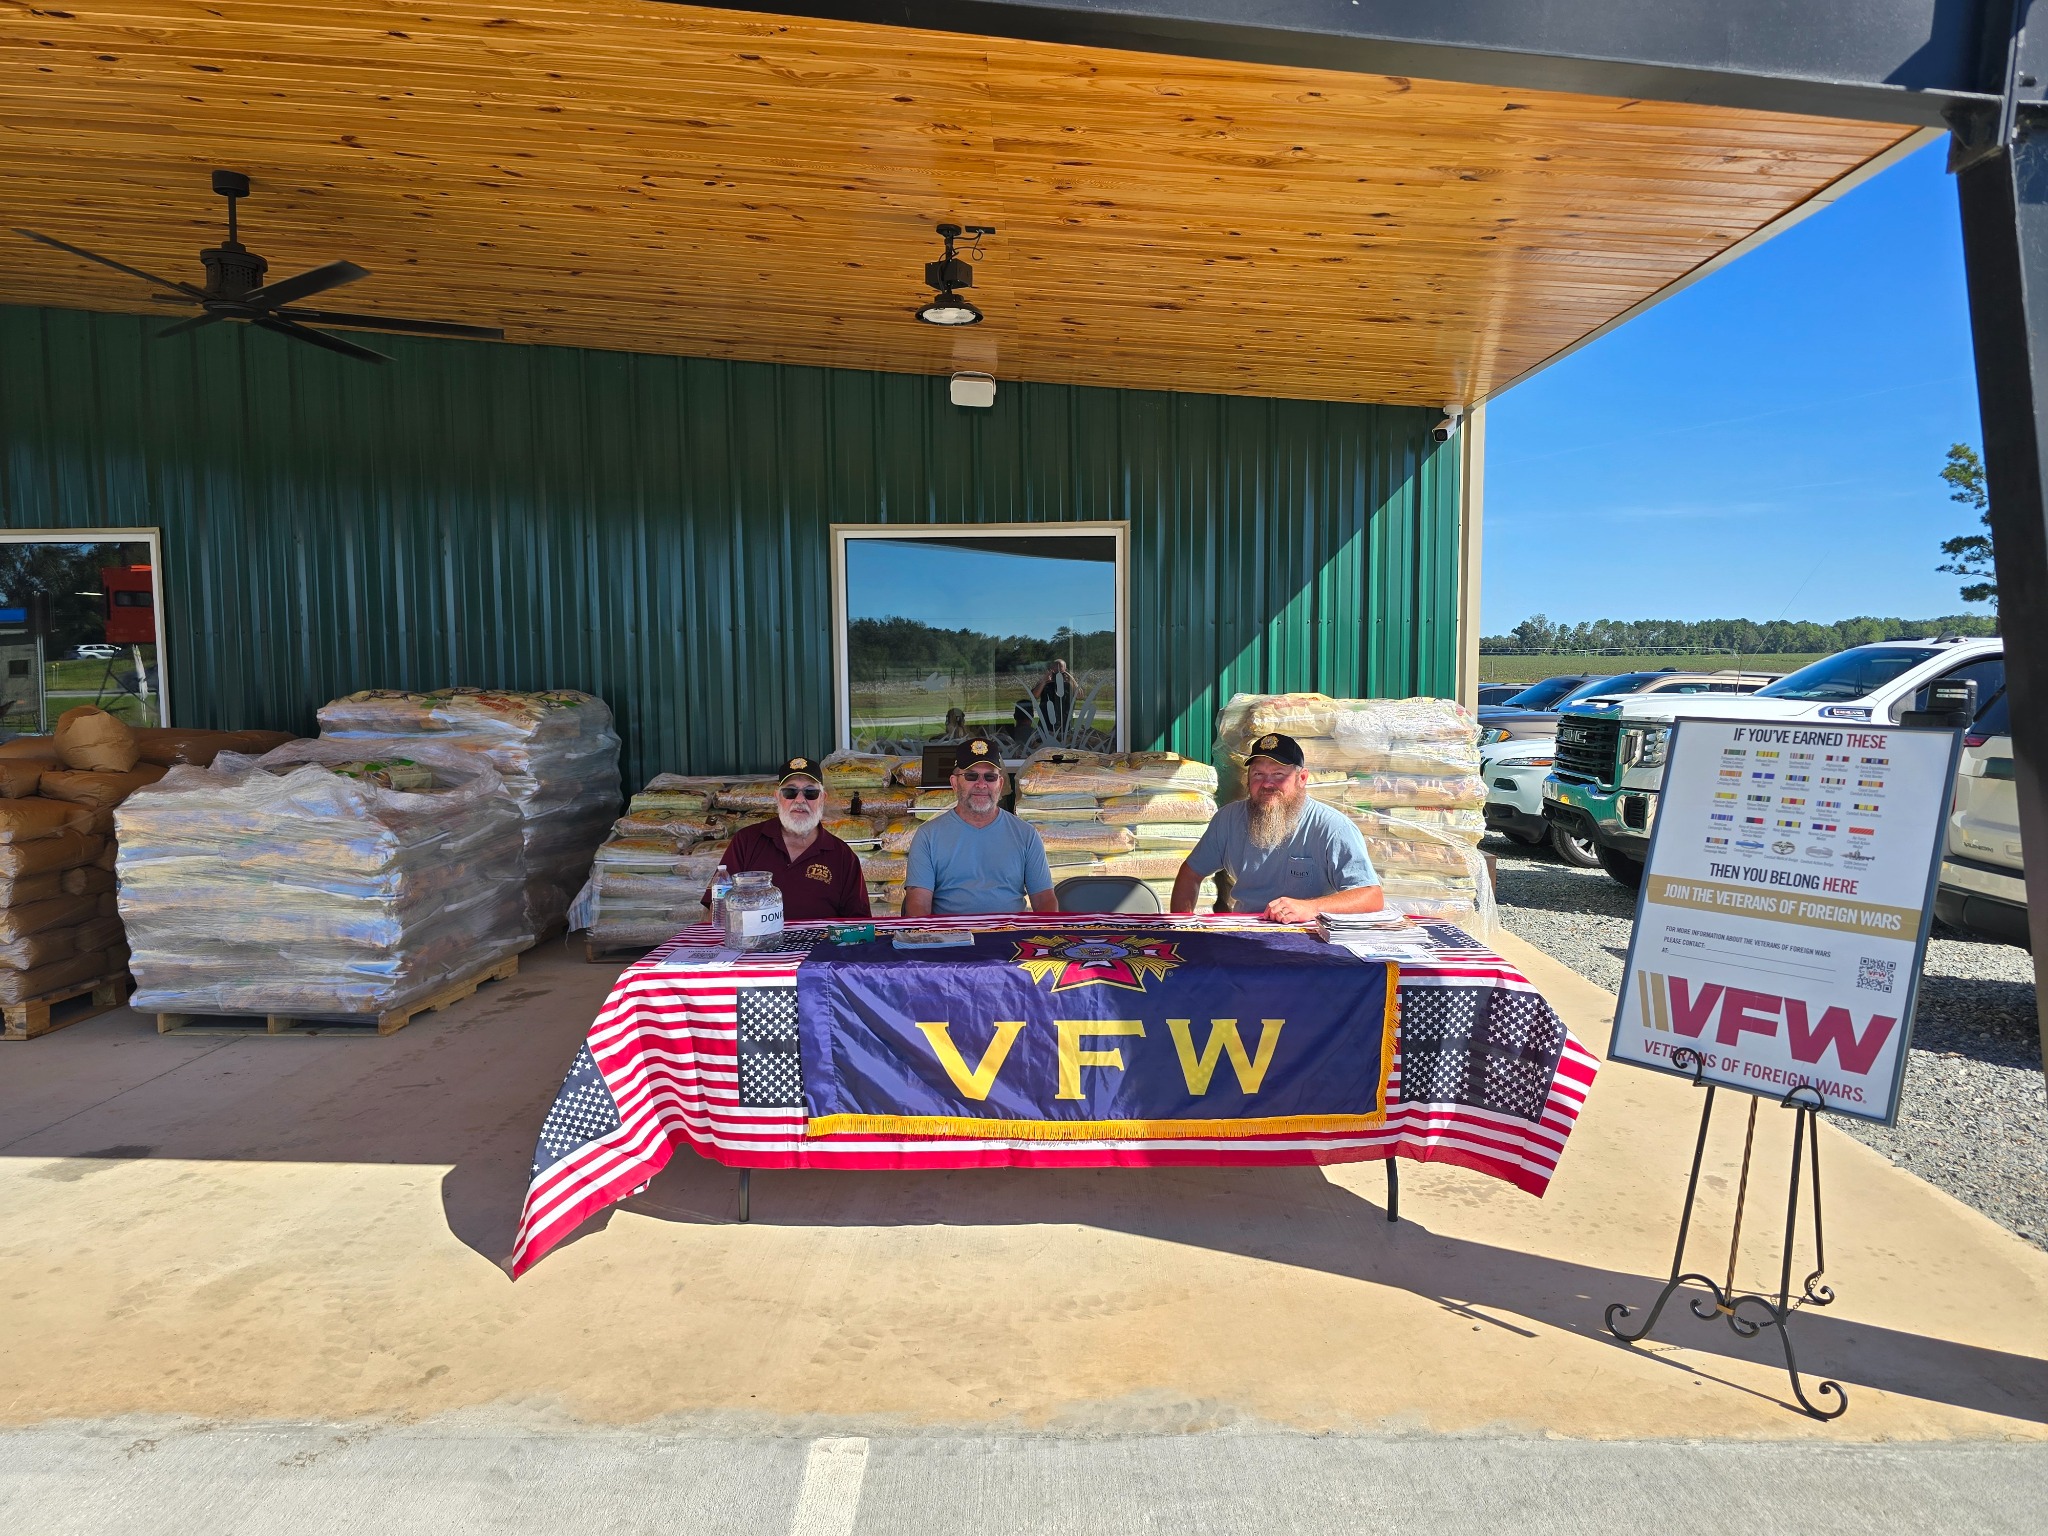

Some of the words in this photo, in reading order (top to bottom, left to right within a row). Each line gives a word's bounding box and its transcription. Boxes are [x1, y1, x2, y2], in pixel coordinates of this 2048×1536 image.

[1733, 728, 1746, 741] IF
[1749, 728, 1791, 744] YOU'VE
[1792, 731, 1843, 747] EARNED
[1846, 733, 1888, 749] THESE
[1710, 862, 1741, 879] THEN
[1743, 866, 1768, 883] YOU
[1770, 870, 1820, 890] BELONG
[1822, 876, 1859, 895] HERE
[1664, 883, 1690, 900] JOIN
[1692, 887, 1714, 903] THE
[1716, 890, 1777, 913] VETERANS
[1779, 899, 1797, 915] OF
[1798, 902, 1858, 925] FOREIGN
[1860, 909, 1902, 931] WARS
[1663, 936, 1681, 944] PLEASE
[1682, 939, 1705, 948] CONTACT:
[1676, 927, 1691, 935] MORE
[1692, 929, 1725, 940] INFORMATION
[1726, 934, 1743, 943] ABOUT
[1744, 937, 1753, 945] THE
[1754, 939, 1780, 949] VETERANS
[1789, 945, 1814, 955] FOREIGN
[1815, 949, 1831, 957] WARS
[1667, 975, 1898, 1076] VFW
[1721, 1057, 1740, 1072] OF
[1743, 1061, 1810, 1088] FOREIGN
